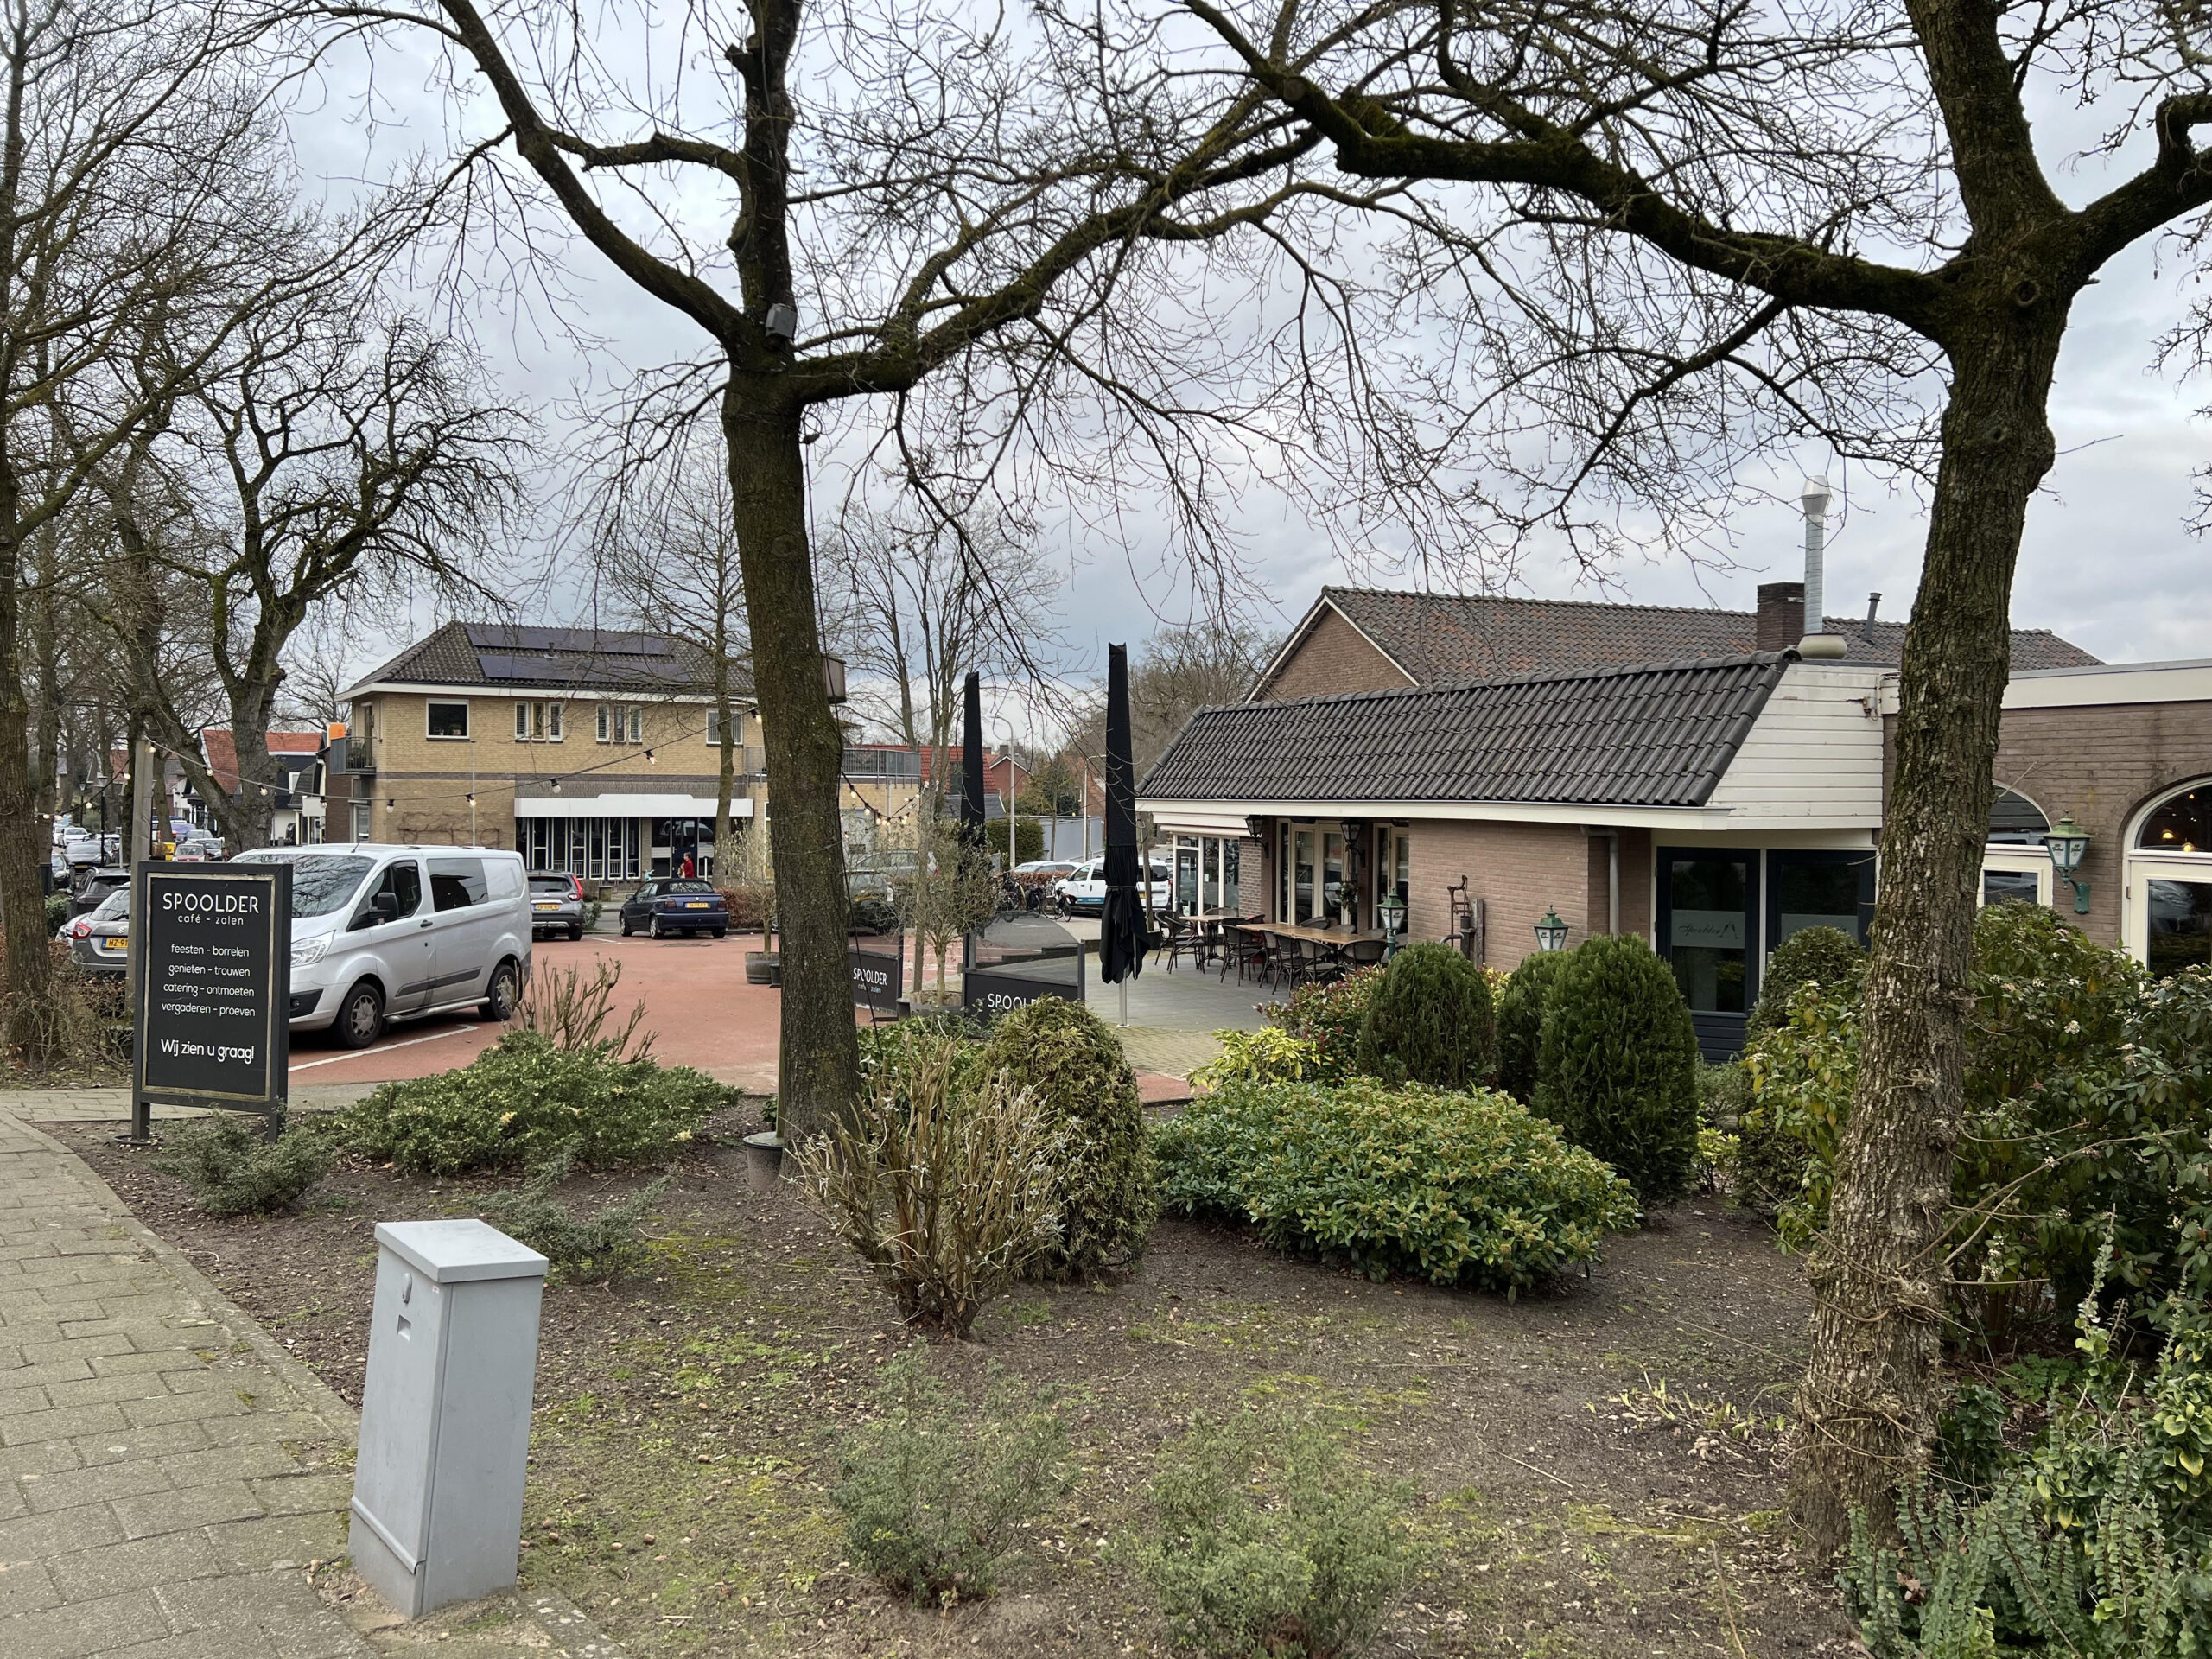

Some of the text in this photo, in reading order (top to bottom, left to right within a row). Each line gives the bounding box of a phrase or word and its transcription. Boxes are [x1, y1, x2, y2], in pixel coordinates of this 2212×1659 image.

[162, 893, 260, 914] SPOOLDER
[177, 913, 201, 924] café
[215, 916, 244, 925] zalen
[171, 943, 205, 955] feesten
[213, 945, 250, 957] borrelen
[168, 963, 206, 976] genieten
[214, 966, 251, 977] trouwen
[853, 968, 887, 986] SPOOLDER
[163, 982, 199, 997] catering
[207, 985, 255, 997] ontmoeten
[162, 1002, 211, 1015] vergaderen
[219, 1006, 256, 1017] proeven
[161, 1038, 255, 1065] Wij zien u graag!
